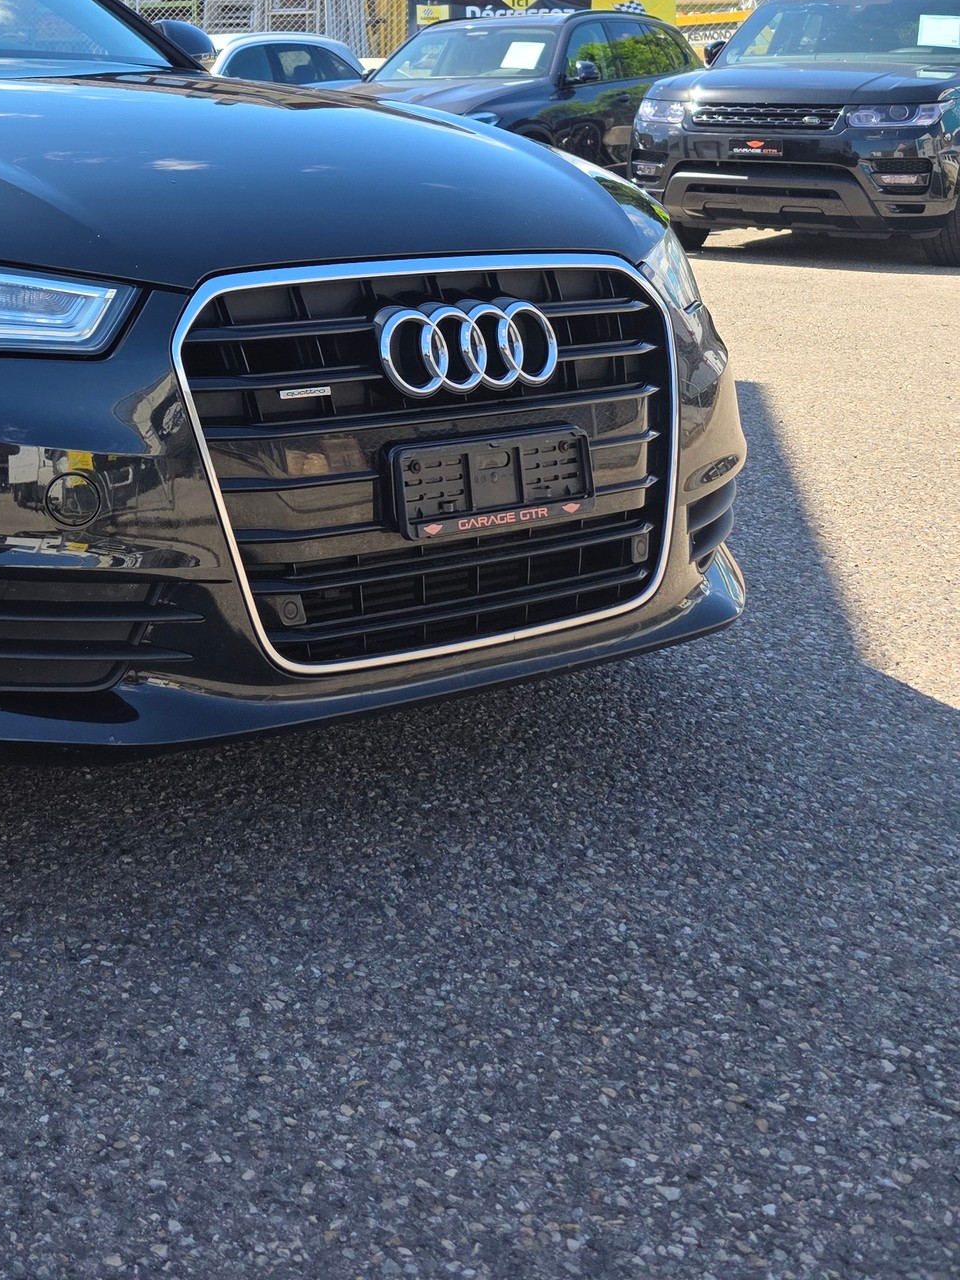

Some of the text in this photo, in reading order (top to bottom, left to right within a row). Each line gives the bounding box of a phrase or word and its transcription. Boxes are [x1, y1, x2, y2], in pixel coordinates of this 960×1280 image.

[286, 388, 326, 397] quattro
[458, 507, 549, 531] GARAGE GTR
